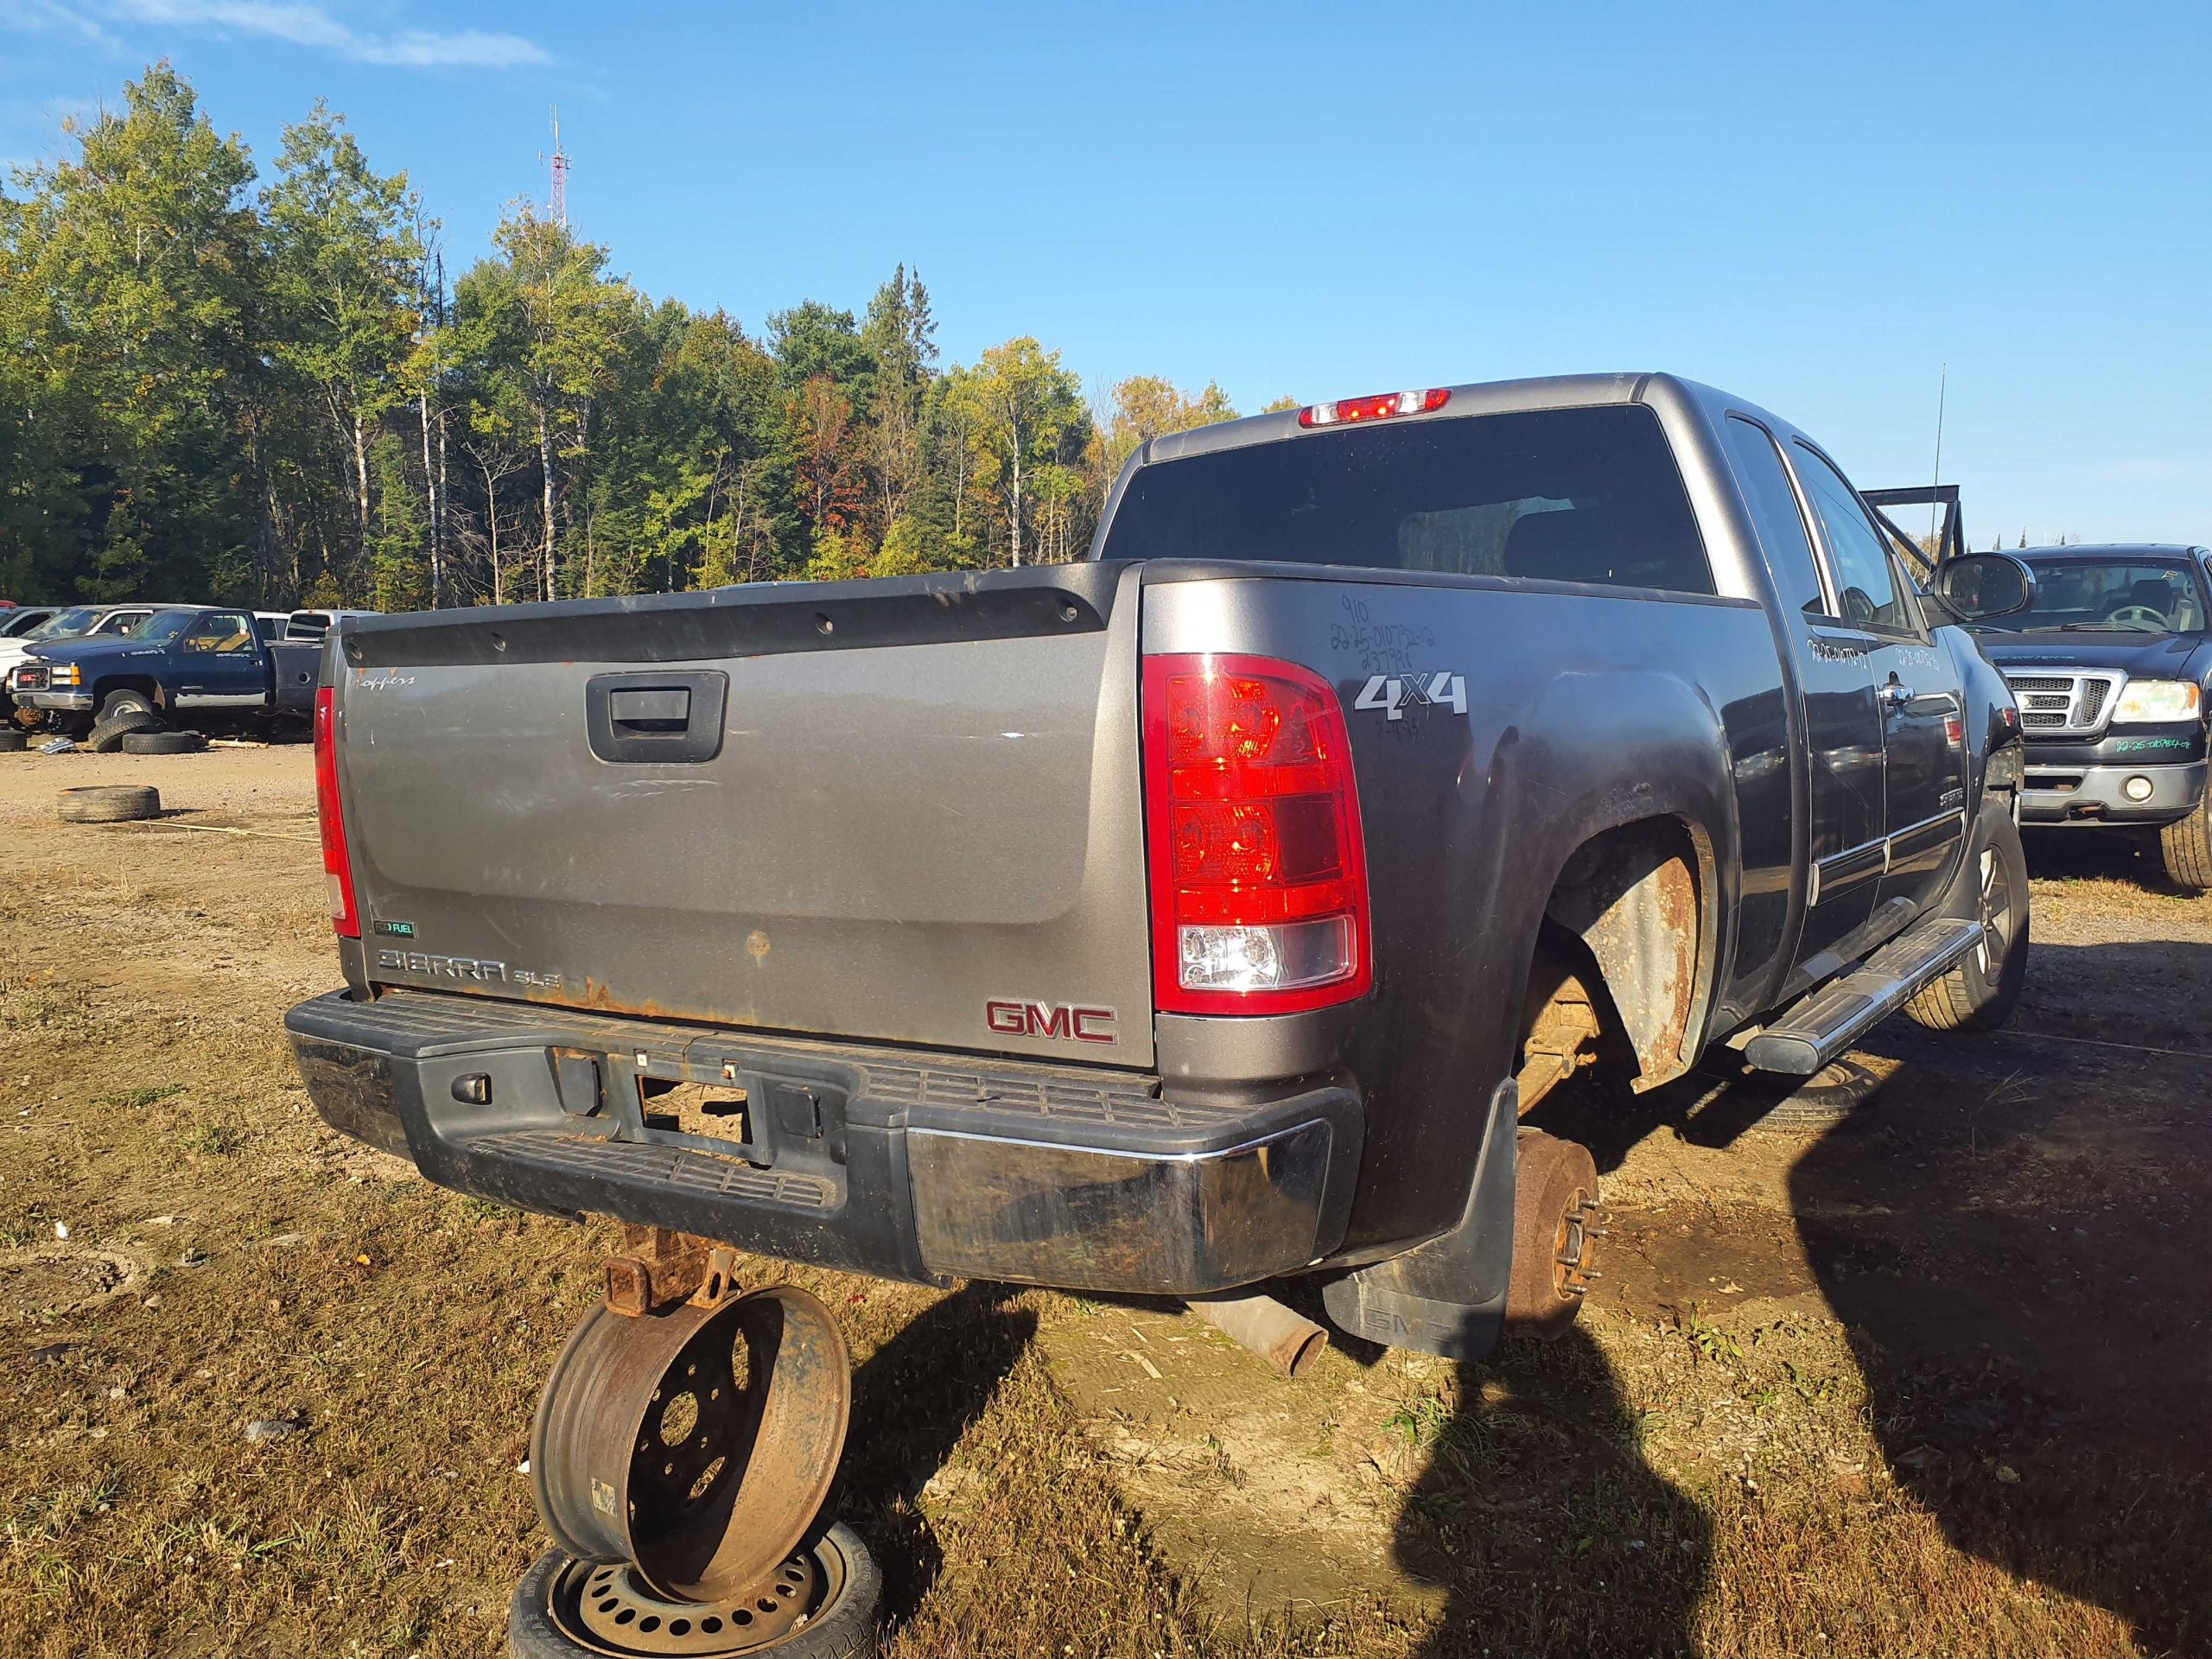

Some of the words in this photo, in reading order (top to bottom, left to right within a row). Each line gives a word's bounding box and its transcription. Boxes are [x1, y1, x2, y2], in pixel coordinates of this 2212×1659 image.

[1341, 594, 1370, 624] 910
[392, 923, 413, 934] FUEL
[378, 949, 506, 982] SIERRA
[513, 969, 562, 989] SLE
[986, 995, 1119, 1045] GMC
